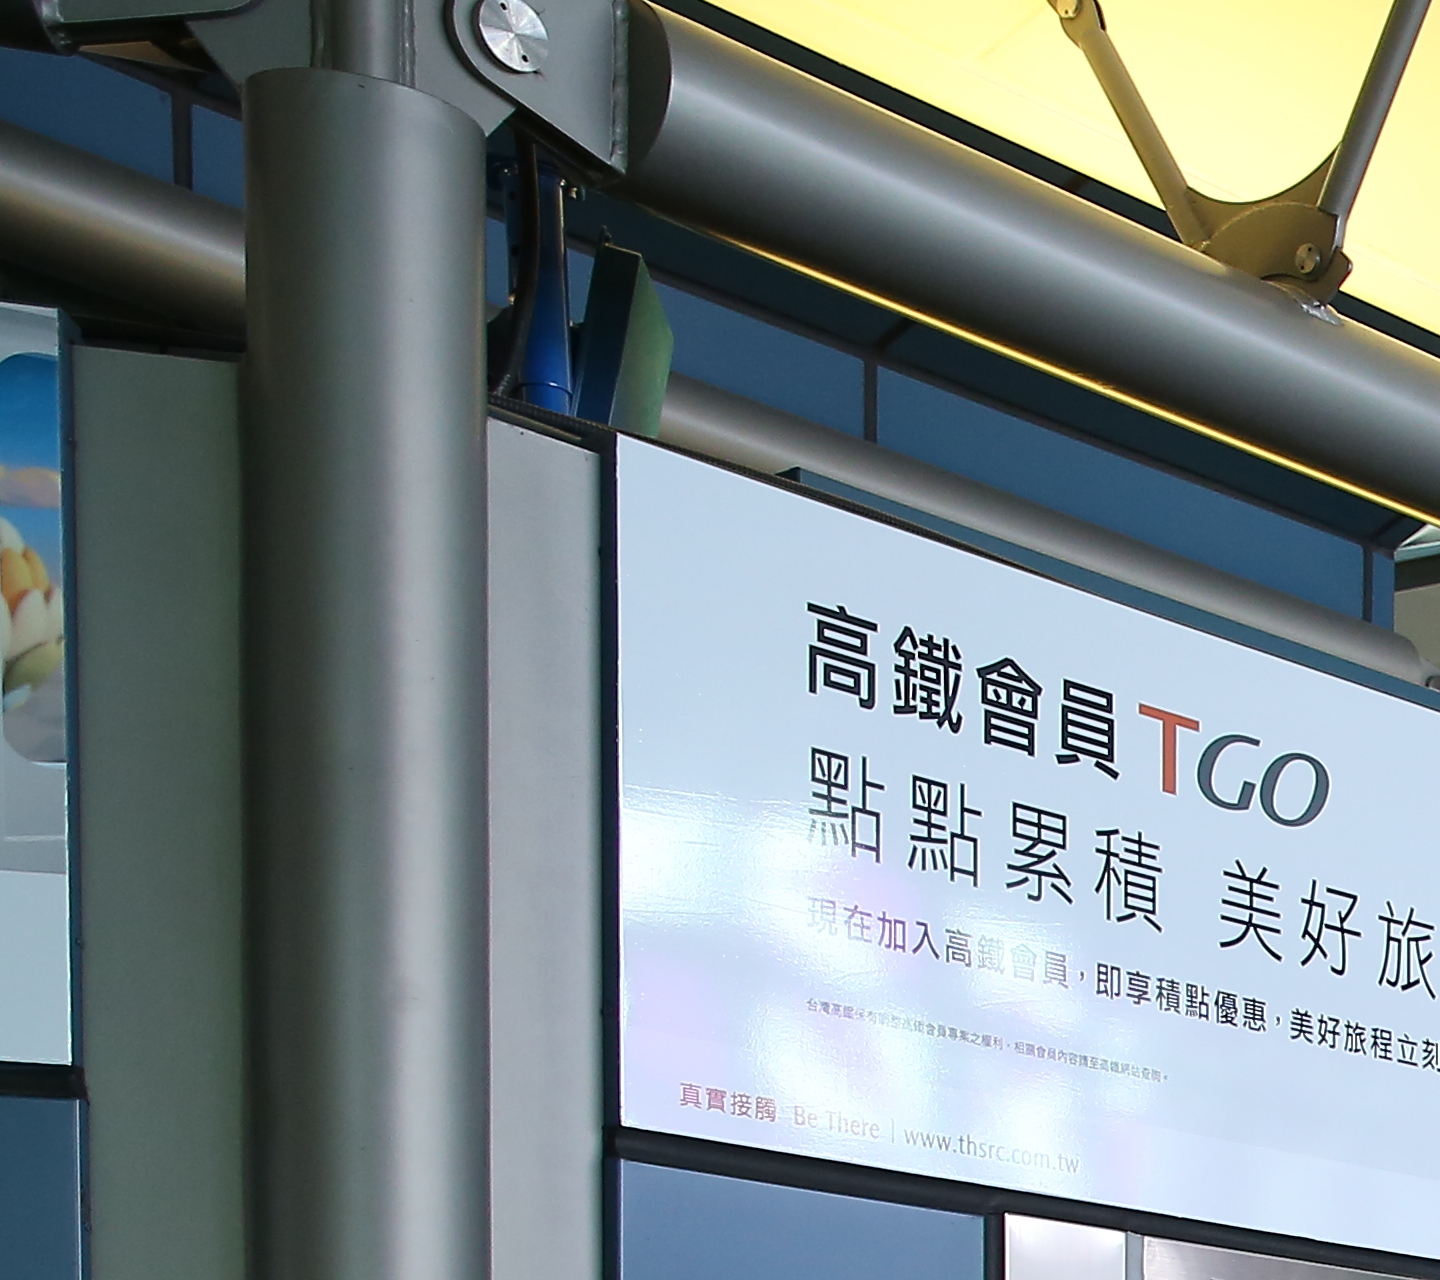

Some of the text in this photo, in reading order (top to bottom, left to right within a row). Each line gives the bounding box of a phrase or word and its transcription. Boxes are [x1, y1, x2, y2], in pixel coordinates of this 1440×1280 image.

[807, 601, 1331, 827] 高鐵會員 TGO
[807, 746, 1164, 934] 點點累積
[680, 1082, 777, 1124] 真實接觸
[793, 1105, 1081, 1176] Be There www.thsrc.com.tw
